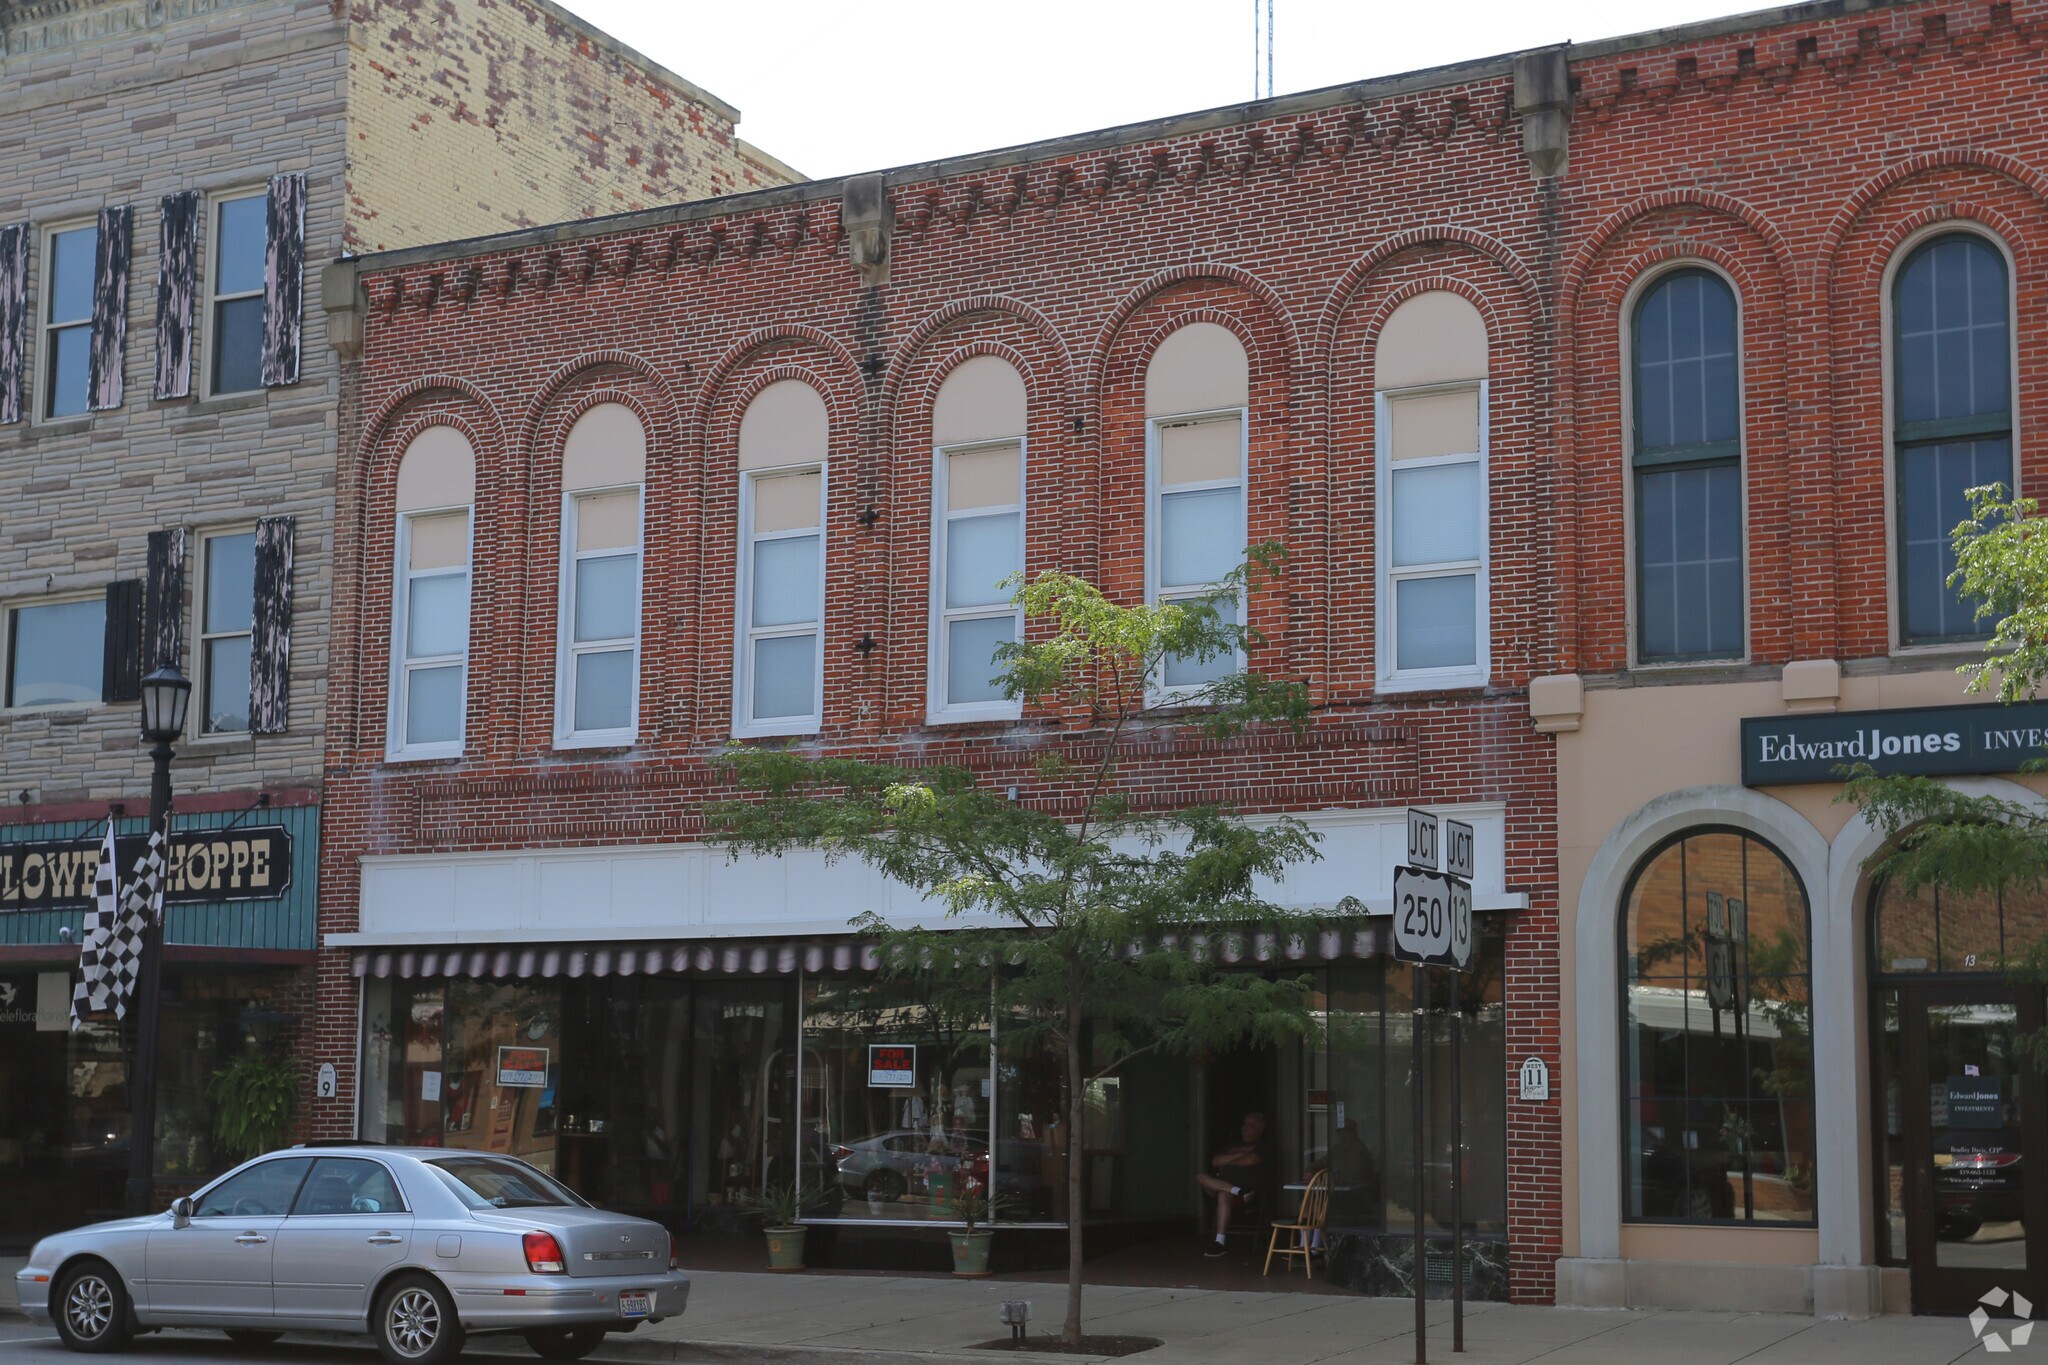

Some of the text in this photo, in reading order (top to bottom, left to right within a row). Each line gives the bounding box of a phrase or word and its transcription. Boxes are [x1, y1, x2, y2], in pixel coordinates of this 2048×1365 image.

[1759, 730, 1866, 763] Edward
[1868, 729, 1961, 760] Jones
[1410, 820, 1436, 860] JCT
[1448, 830, 1472, 869] JCT
[0, 838, 271, 901] LOWE HOPPE
[1403, 893, 1442, 939] 250
[1453, 895, 1468, 945] 13
[1965, 954, 1976, 967] 13
[874, 1060, 911, 1069] SALE
[880, 1049, 905, 1059] FOR
[322, 1081, 331, 1096] 9
[1527, 1069, 1542, 1085] 11
[1950, 1091, 1998, 1100] Edward Jones
